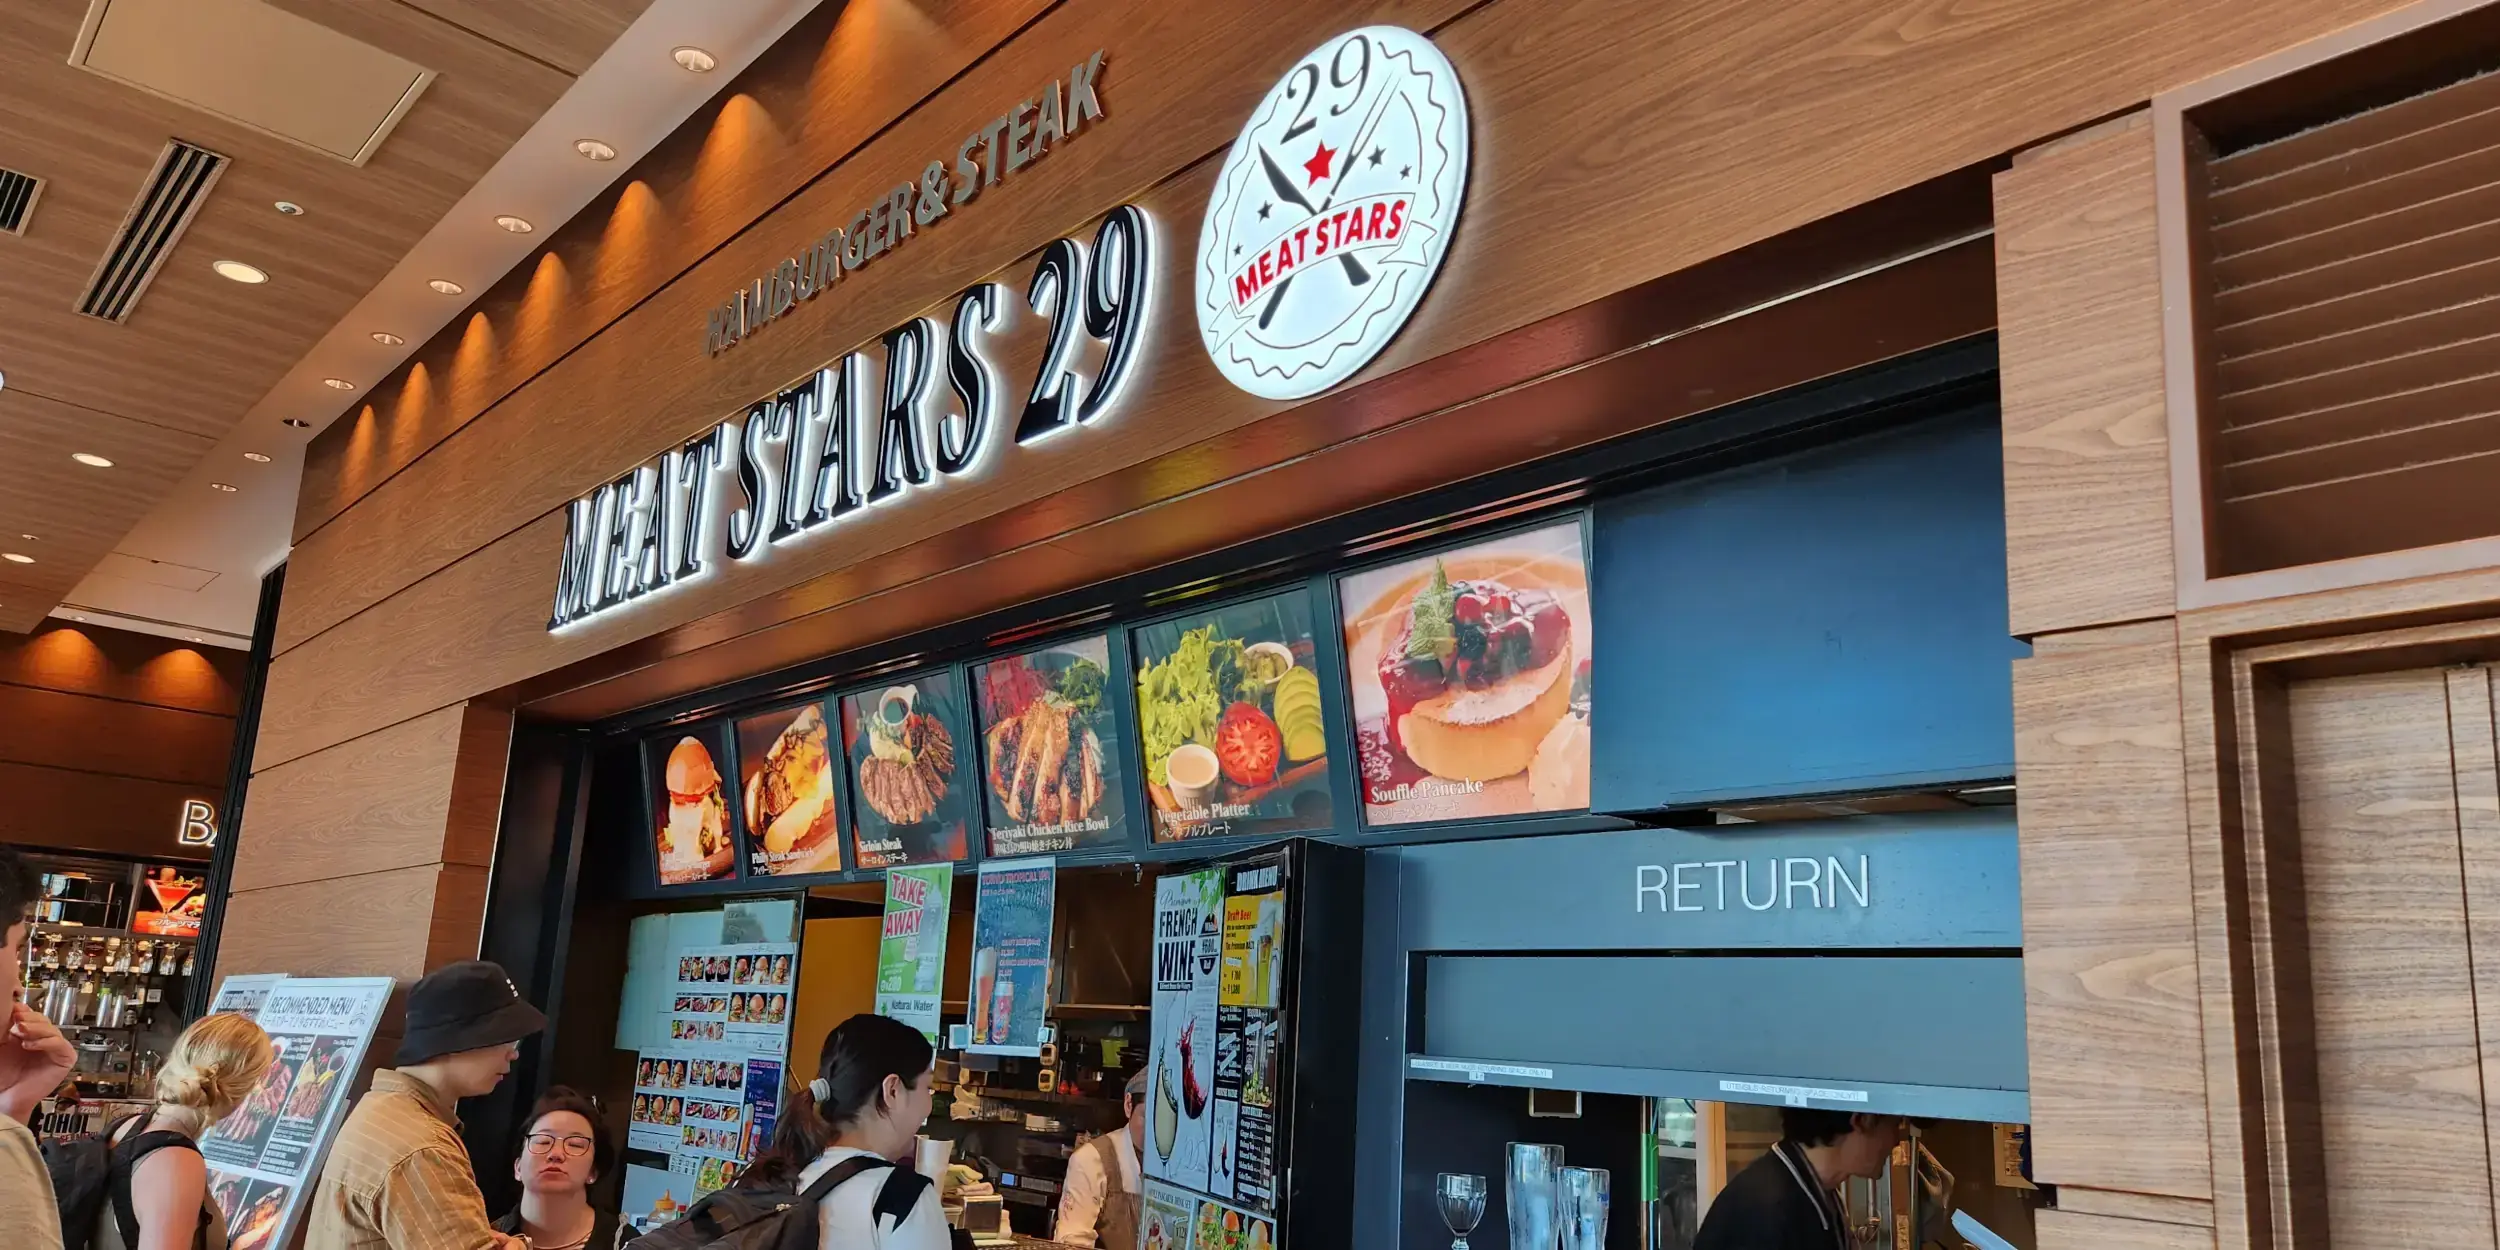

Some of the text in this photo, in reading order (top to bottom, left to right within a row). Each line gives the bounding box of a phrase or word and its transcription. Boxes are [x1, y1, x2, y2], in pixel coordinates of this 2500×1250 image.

[1279, 34, 1372, 145] 29
[1235, 199, 1407, 305] MEAT STARS
[546, 203, 1157, 634] MEAT STARS 29
[1371, 777, 1484, 803] Souffle Pancake
[178, 799, 217, 847] B
[1157, 802, 1252, 827] Vegetable Platter
[991, 815, 1110, 842] Teriyaki Chicken Rice Bowl
[751, 848, 816, 865] Philly Steak Sandwich
[859, 838, 903, 853] Sirloin Steak
[860, 854, 909, 865] サーロインステーキ
[892, 873, 927, 907] TAKE
[1005, 871, 1037, 884] TROPICAL
[1236, 865, 1279, 892] DRINK MENU
[1636, 854, 1870, 913] RETURN
[885, 909, 923, 938] AWAY
[1159, 907, 1199, 938] FRENCH
[1227, 909, 1252, 921] Draft Beer
[1158, 940, 1197, 982] WINE
[268, 996, 329, 1015] RECOMMENDED
[328, 996, 356, 1016] MENU
[892, 1000, 934, 1012] Natural Water
[1477, 1064, 1507, 1073] RETURNING
[1508, 1066, 1528, 1075] SPACE
[1726, 1082, 1759, 1092] UTENSILS
[1761, 1085, 1803, 1096] RETURNING
[1804, 1088, 1831, 1097] SPACE
